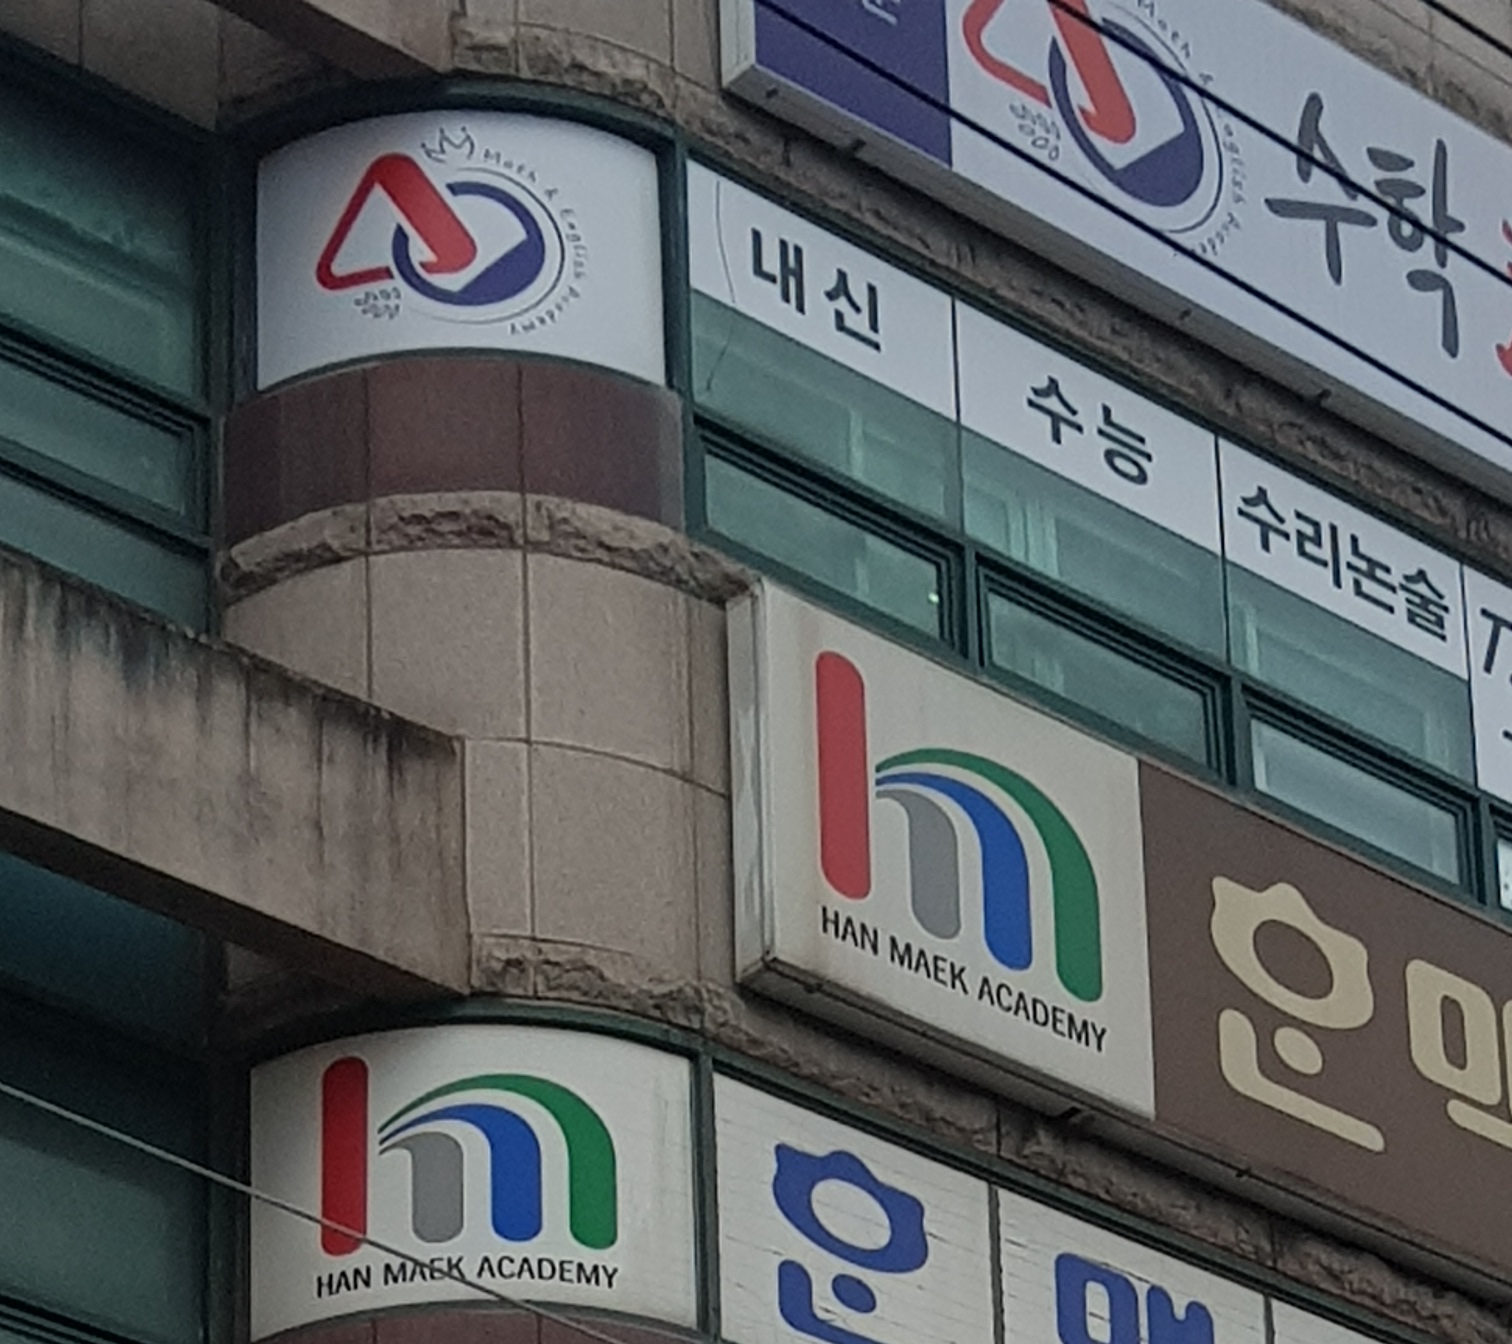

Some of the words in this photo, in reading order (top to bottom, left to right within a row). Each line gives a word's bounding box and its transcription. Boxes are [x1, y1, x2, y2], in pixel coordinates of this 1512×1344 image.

[1264, 92, 1466, 359] 수학
[749, 226, 882, 354] 내신
[1026, 374, 1153, 486] 수능
[1236, 485, 1450, 643] 수리논술
[820, 904, 881, 957] HAN
[889, 938, 969, 998] MAEK
[977, 975, 1109, 1054] ACADEMY
[315, 1263, 373, 1299] HAN
[382, 1256, 468, 1287] MAEK
[476, 1255, 620, 1291] ACADEMY
